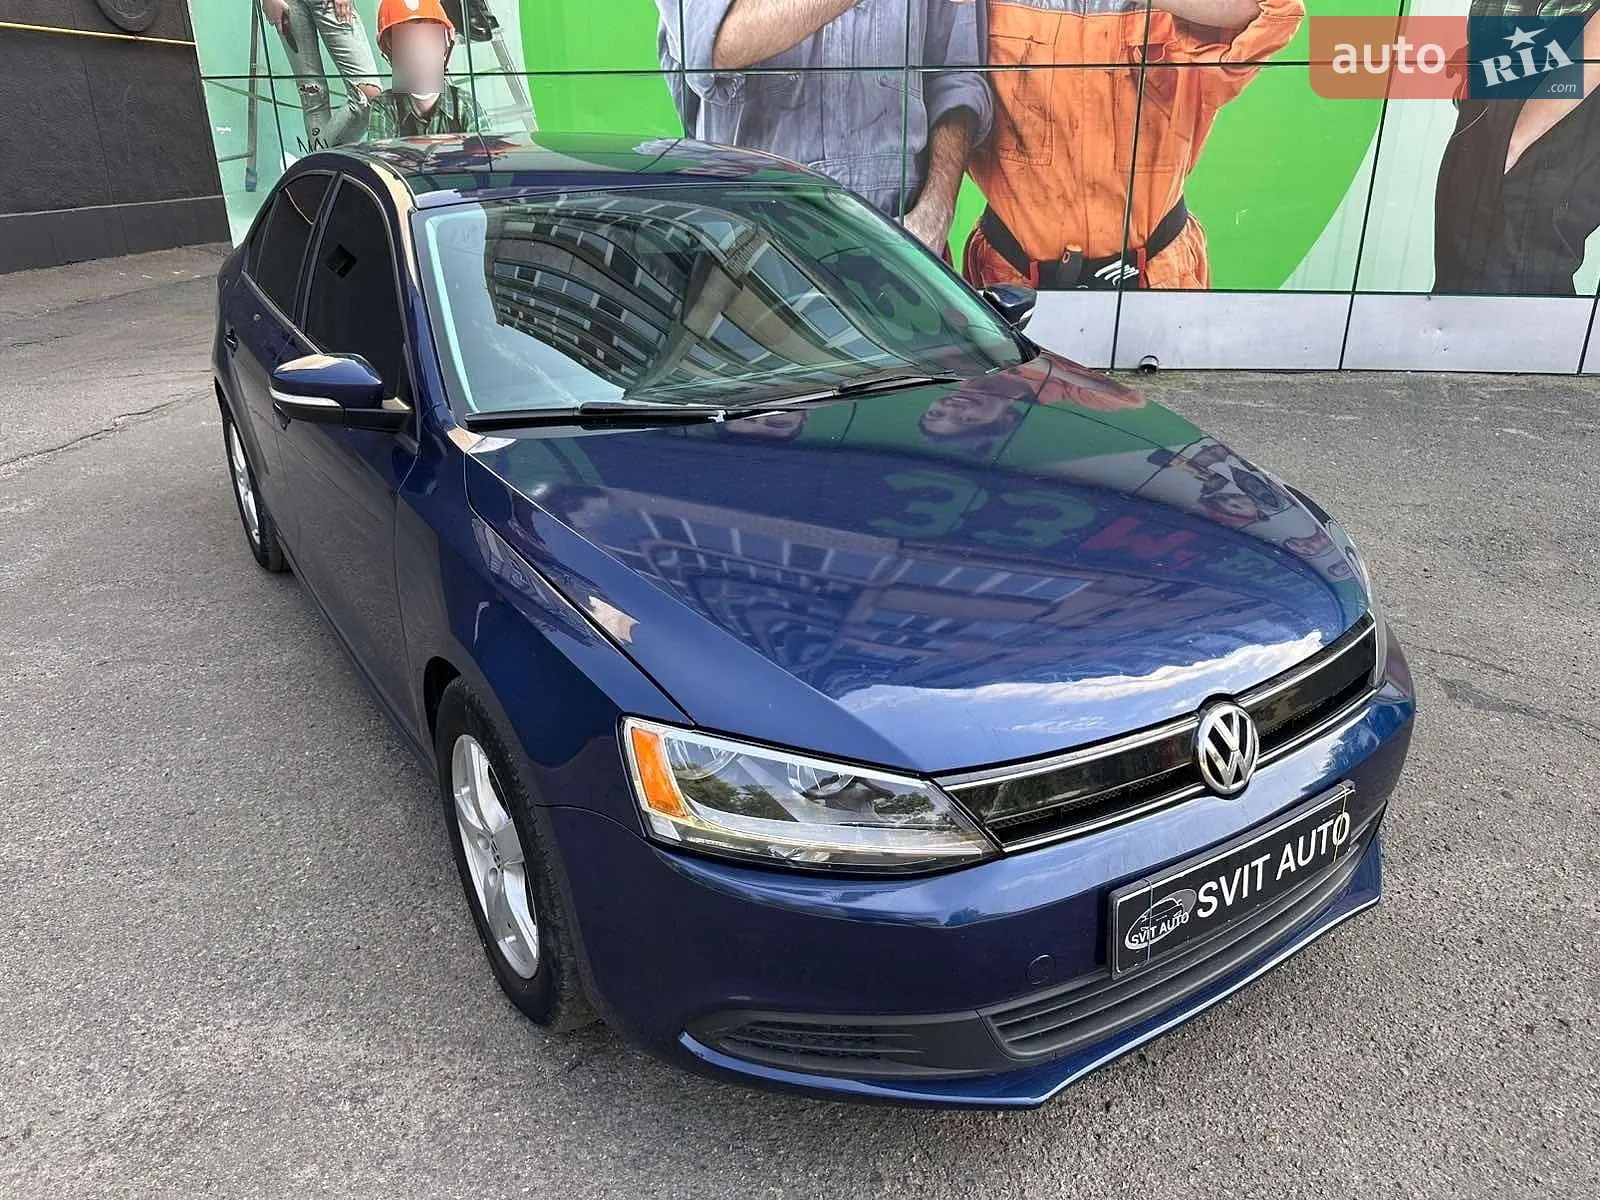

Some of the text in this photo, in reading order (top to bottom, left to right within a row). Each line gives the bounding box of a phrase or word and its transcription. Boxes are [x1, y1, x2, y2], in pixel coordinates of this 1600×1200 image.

[1196, 811, 1351, 918] SVIT AUTO
[1131, 911, 1190, 945] SVIT AUTO
